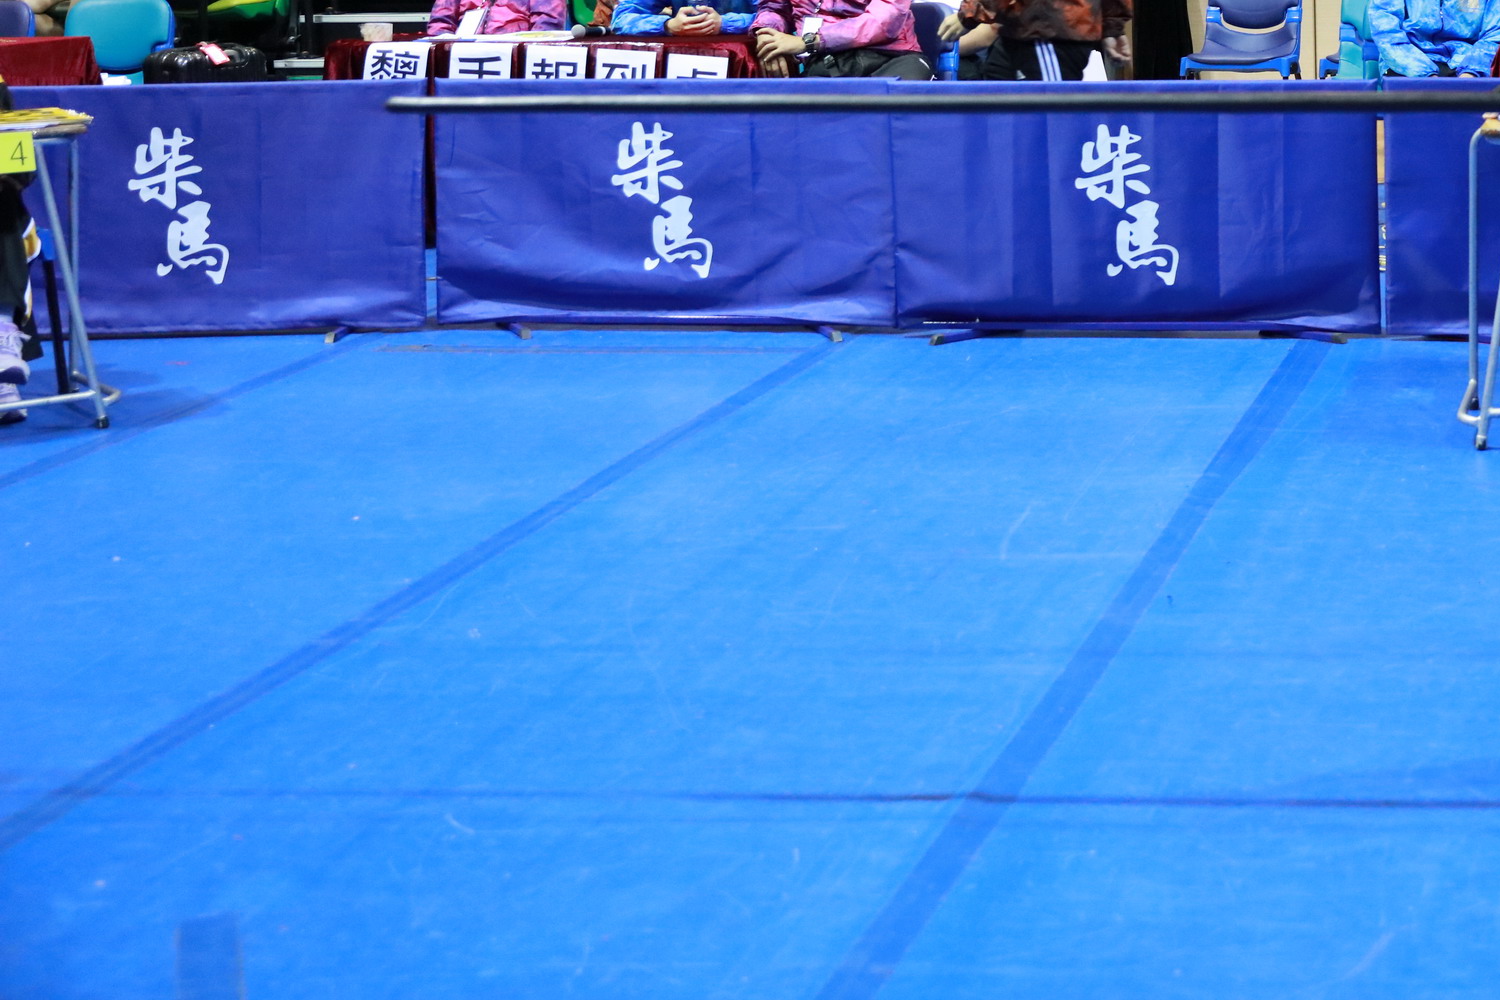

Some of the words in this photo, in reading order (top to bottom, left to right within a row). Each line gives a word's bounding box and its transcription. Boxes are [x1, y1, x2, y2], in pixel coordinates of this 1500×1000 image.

[11, 140, 28, 166] 4
[128, 127, 229, 285] 柴馬
[611, 122, 713, 279] 柴馬
[1075, 124, 1179, 286] 柴馬
